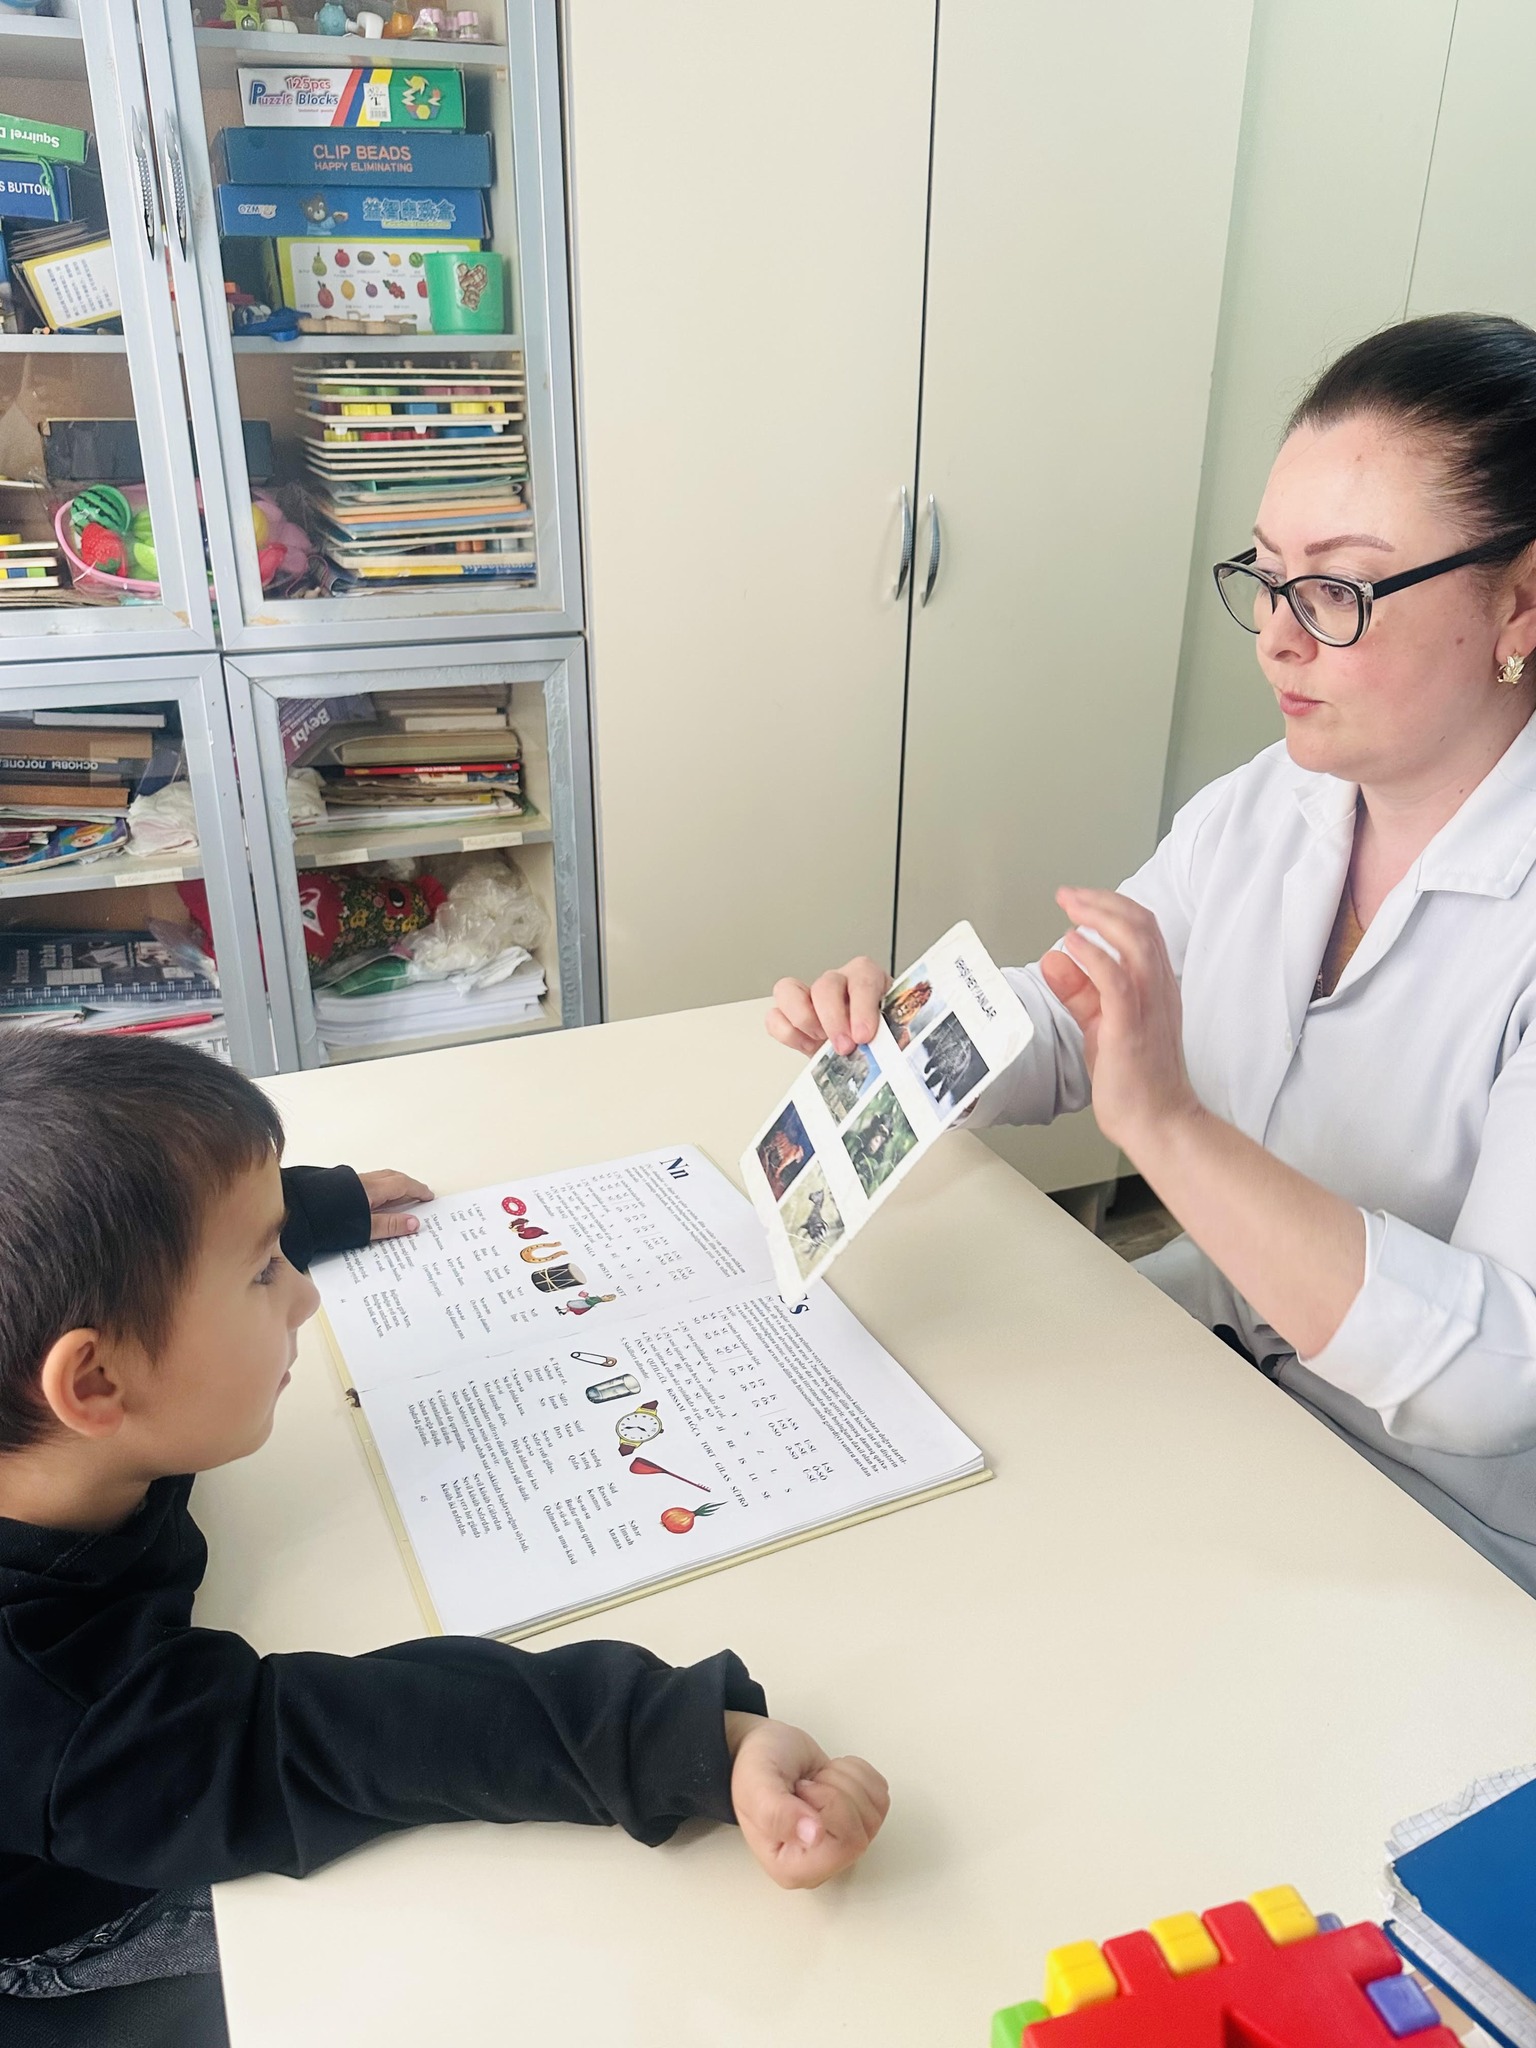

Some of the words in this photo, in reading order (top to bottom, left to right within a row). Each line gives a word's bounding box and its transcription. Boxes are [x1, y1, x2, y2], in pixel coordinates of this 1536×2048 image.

[286, 75, 331, 90] 125pcs
[252, 81, 294, 105] Puzzle
[296, 90, 339, 105] Blocks
[10, 128, 60, 148] Squirrel
[313, 144, 351, 159] CLIP
[356, 145, 412, 161] BEADS
[314, 162, 347, 172] HAPPY
[351, 163, 413, 173] ELIMINATING
[52, 761, 98, 770] ОСНОВЫ
[659, 1156, 691, 1180] Nn
